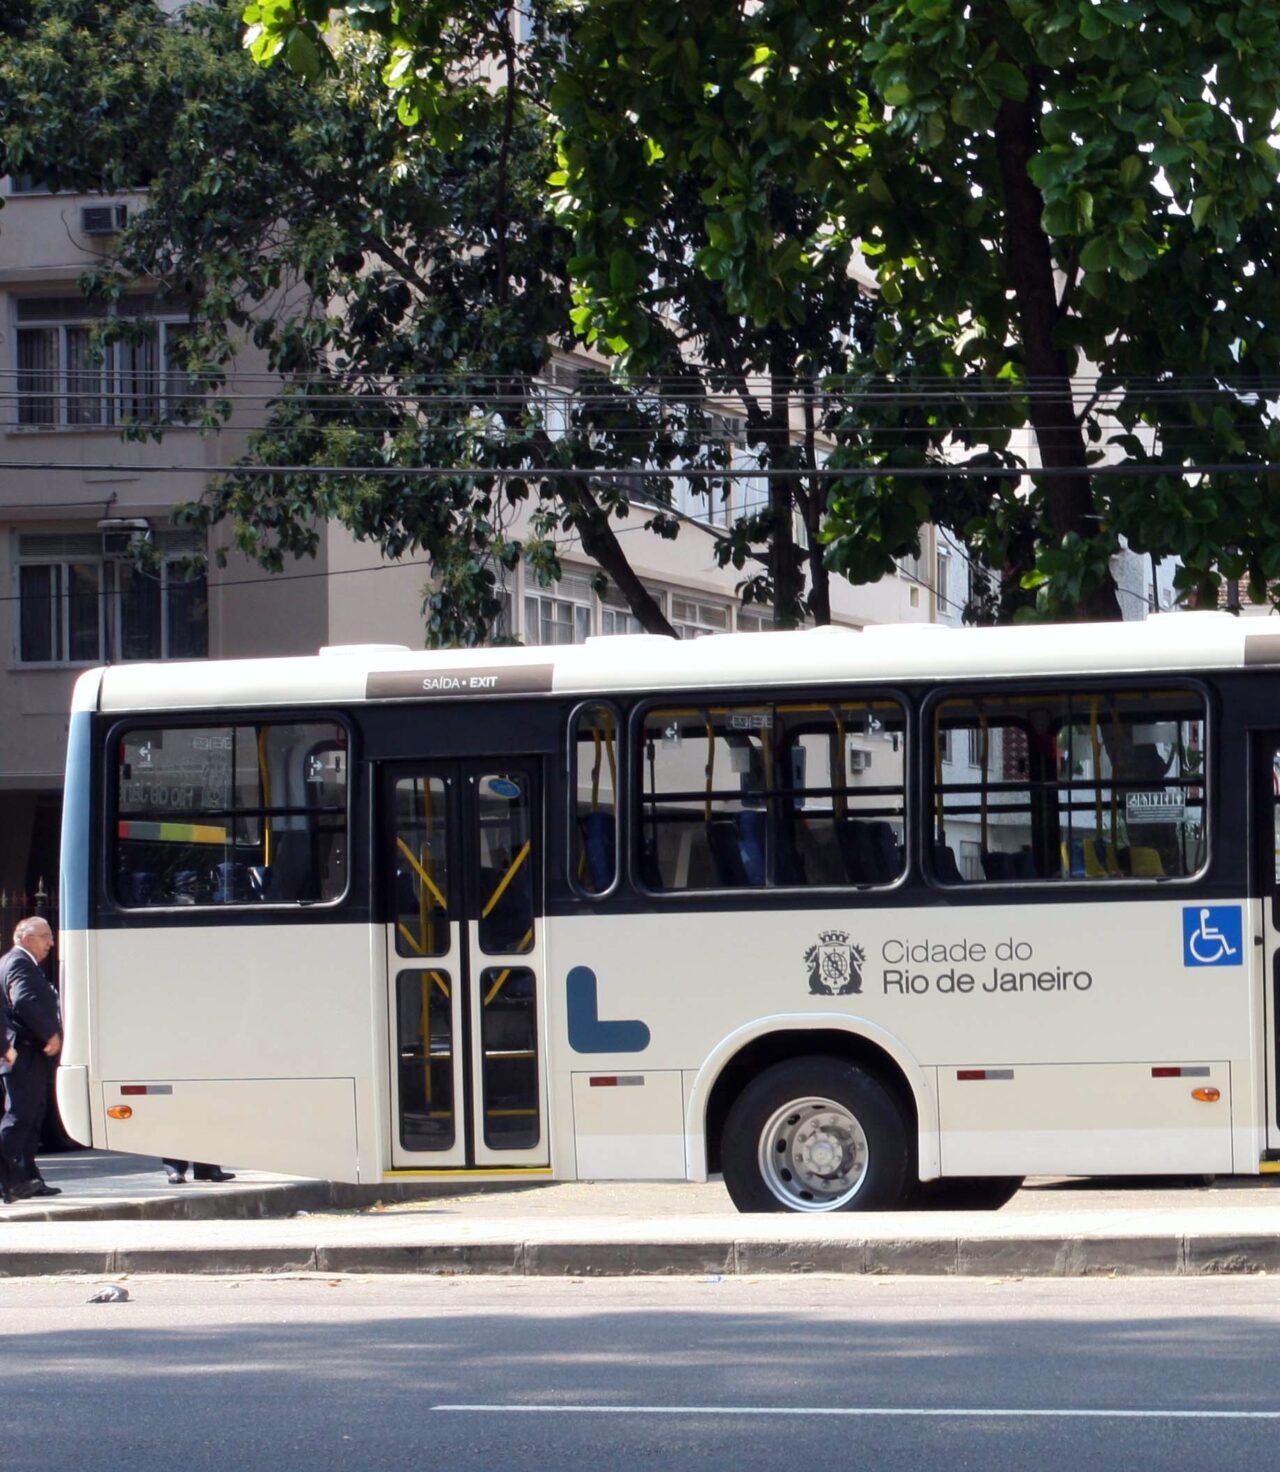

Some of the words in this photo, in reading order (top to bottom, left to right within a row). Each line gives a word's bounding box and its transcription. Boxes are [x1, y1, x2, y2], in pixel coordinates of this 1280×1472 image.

[422, 676, 461, 690] SAÍDA
[470, 676, 498, 688] EXIT
[882, 938, 986, 964] Cidade
[995, 937, 1033, 962] do
[882, 969, 929, 994] Rio
[936, 968, 975, 993] de
[982, 966, 1093, 993] Janeiro
